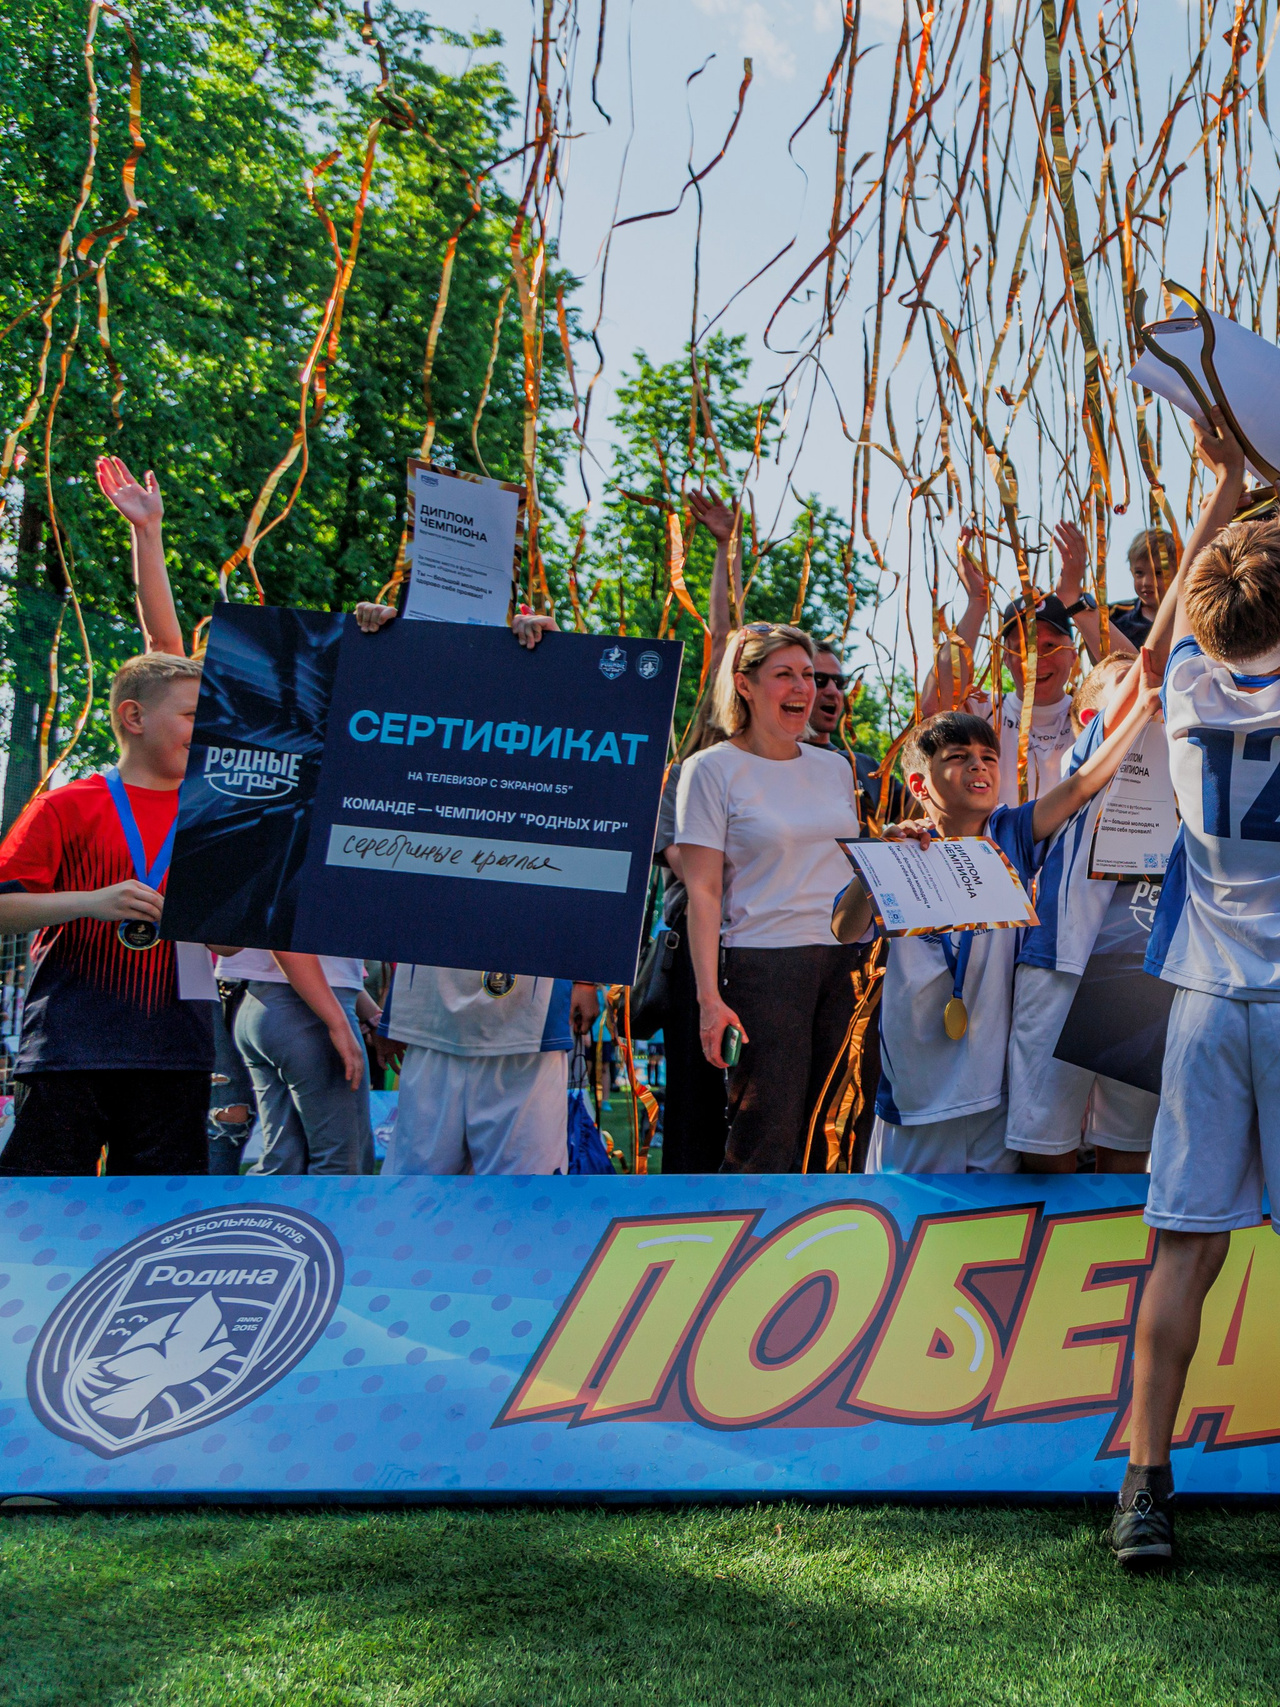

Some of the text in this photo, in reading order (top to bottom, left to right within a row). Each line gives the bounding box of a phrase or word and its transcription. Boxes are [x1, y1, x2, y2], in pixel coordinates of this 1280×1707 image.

[420, 516, 488, 542] ЧЕМПИОНА
[421, 504, 474, 526] ДИПЛОМ
[348, 709, 649, 766] СЕРТИФИКАТ
[204, 746, 303, 781] РОДНЫЕ
[407, 771, 423, 782] НА
[426, 772, 488, 788] ТЕЛЕВИЗОР
[490, 779, 498, 789] С
[499, 779, 553, 794] ЭКРАНОМ
[342, 796, 416, 815] КОМАНДЕ
[435, 805, 516, 824] ЧЕМПИОНУ
[520, 812, 591, 832] "РОДНЫХ
[592, 820, 629, 833] ИГР"
[944, 843, 977, 899] ЧЕМПИОНА
[951, 844, 983, 885] ДИПЛОМ
[160, 1217, 307, 1245] ФУТБОЛЬНЫЙ КЛУБ
[145, 1266, 279, 1286] Родина
